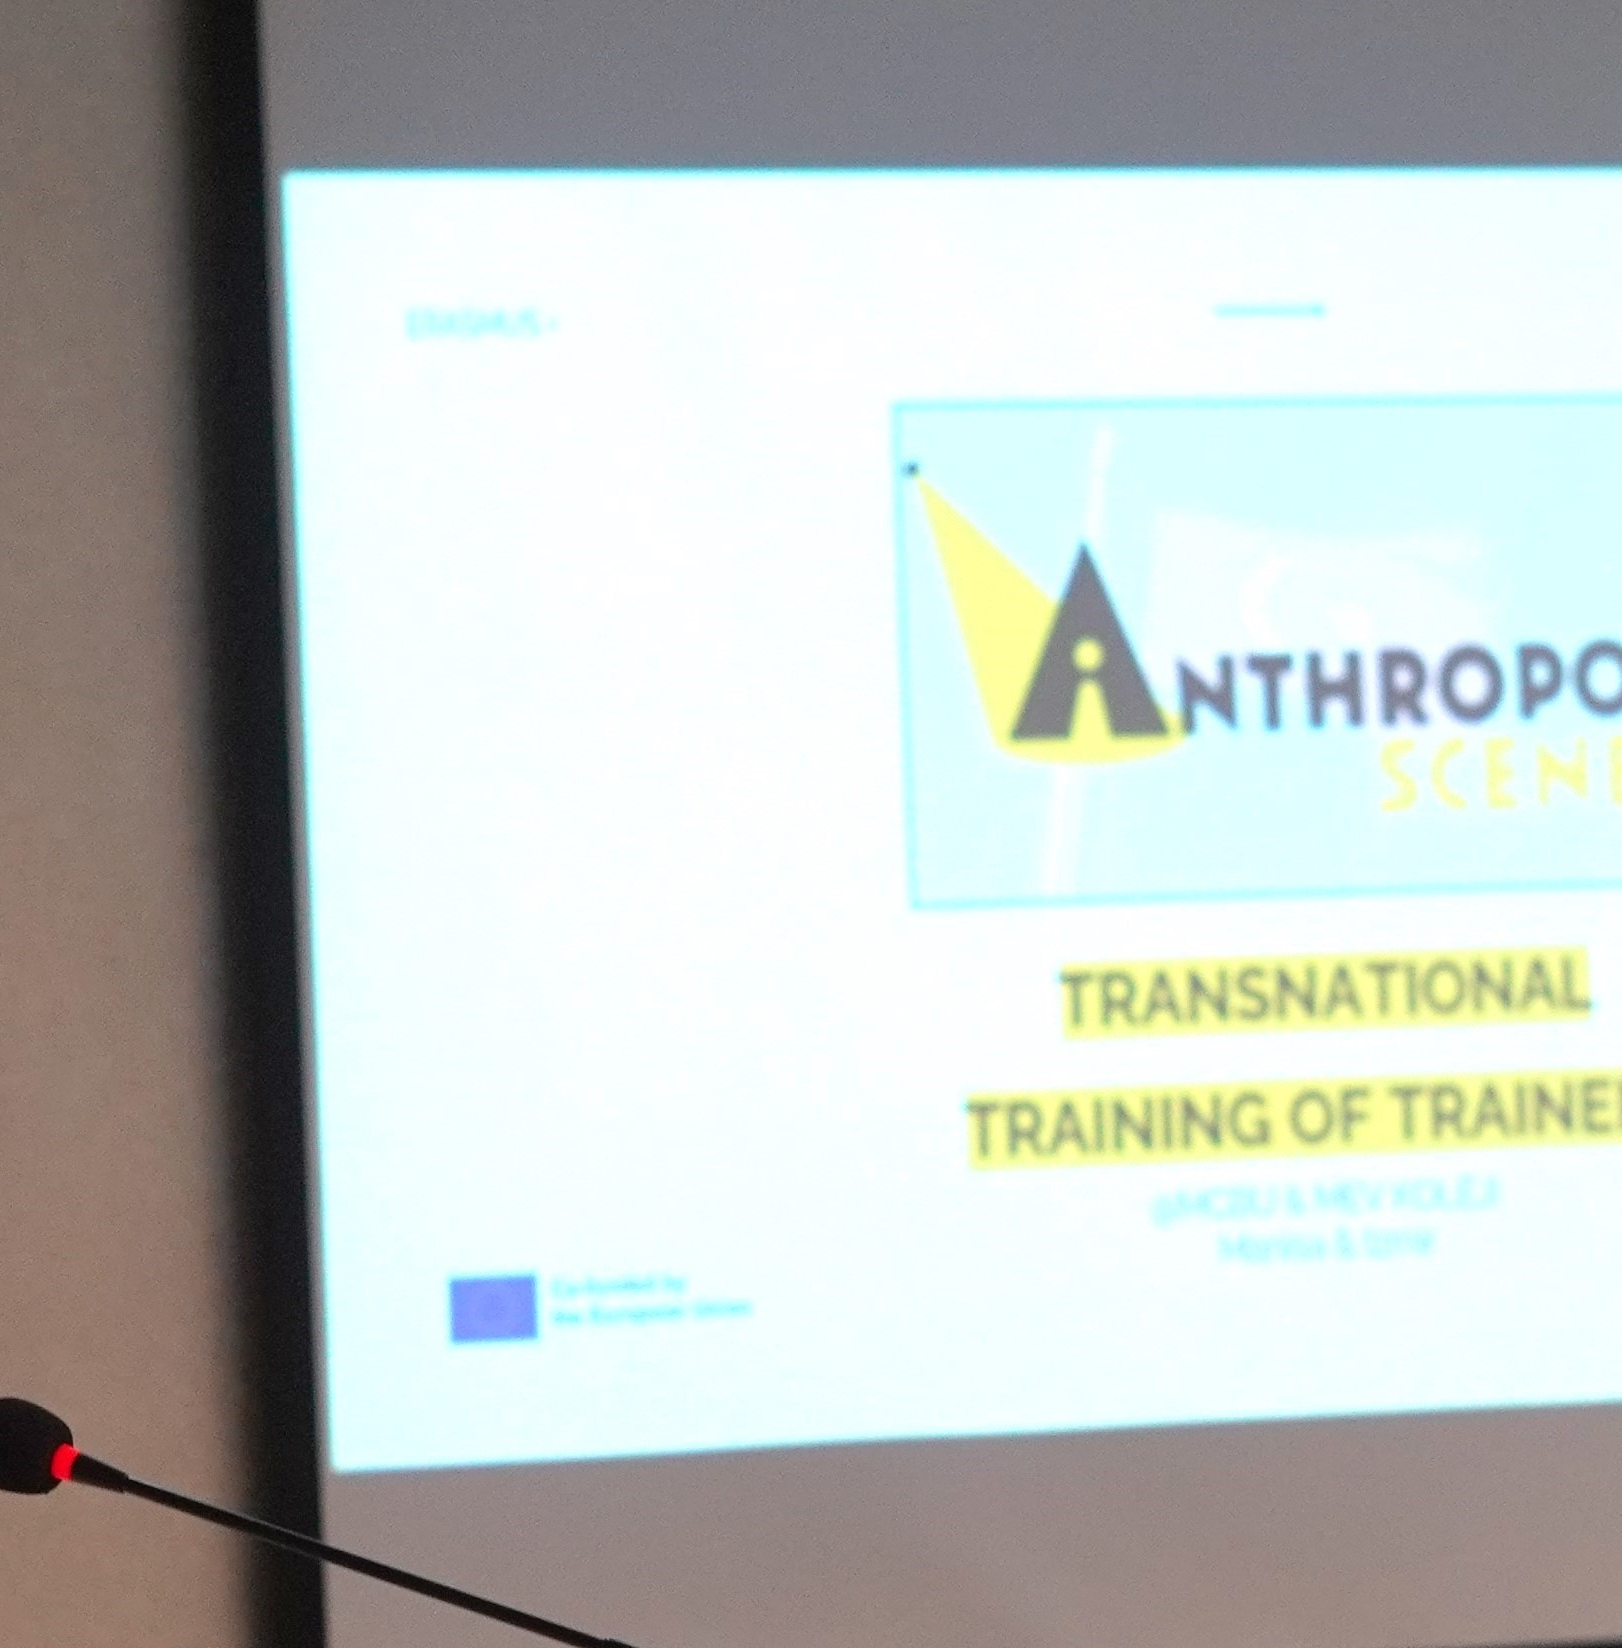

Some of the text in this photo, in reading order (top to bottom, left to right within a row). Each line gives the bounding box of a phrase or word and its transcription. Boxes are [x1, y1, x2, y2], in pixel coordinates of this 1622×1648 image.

[1059, 957, 1593, 1028] TRANSNATIONAL
[966, 1091, 1271, 1157] TRAINING
[1289, 1086, 1372, 1146] OF
